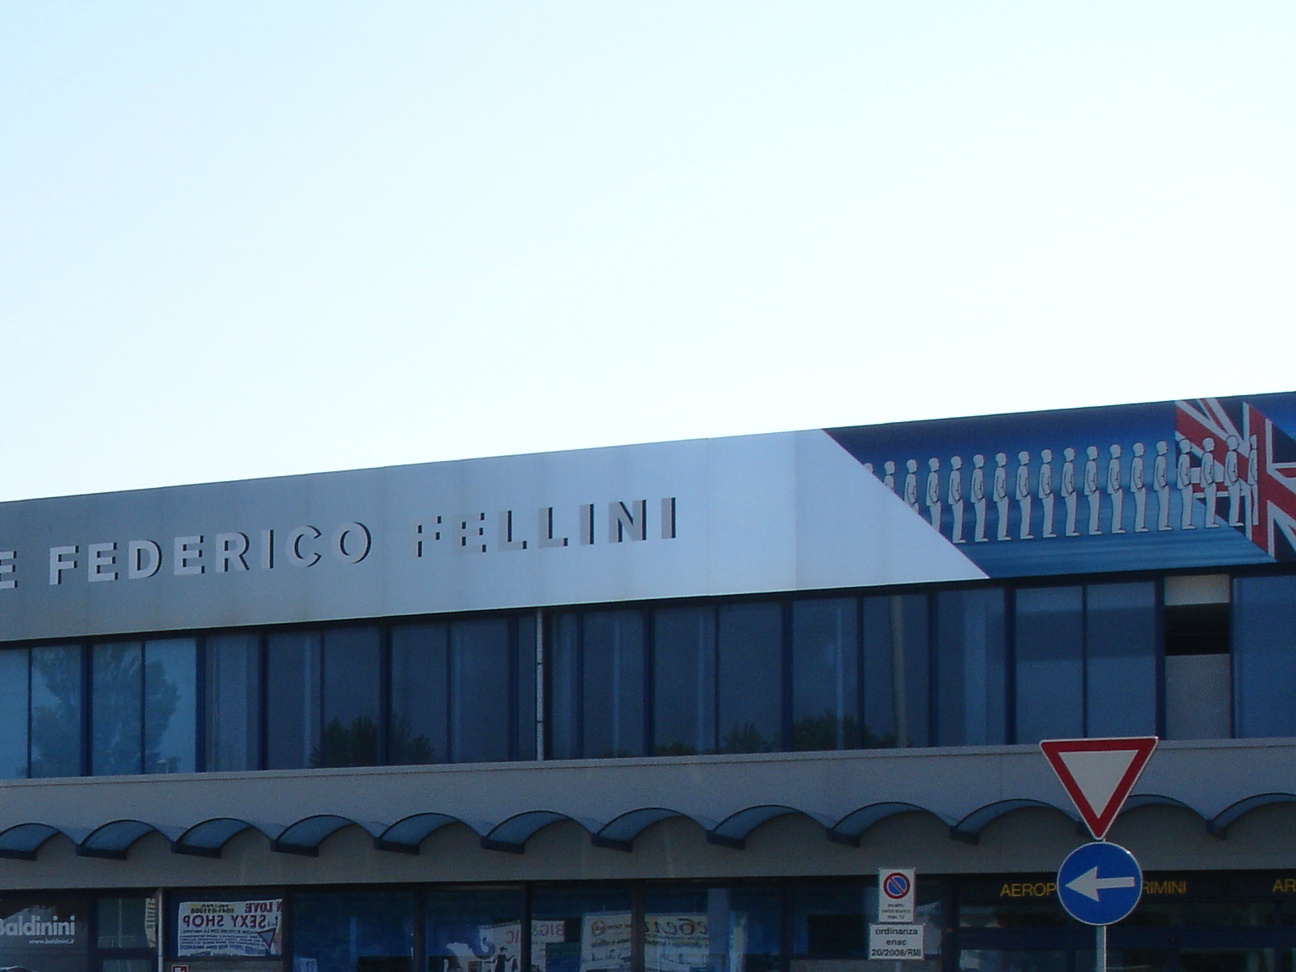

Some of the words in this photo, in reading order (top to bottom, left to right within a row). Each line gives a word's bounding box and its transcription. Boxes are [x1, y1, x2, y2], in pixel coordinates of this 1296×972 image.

[49, 521, 373, 586] FEDERICO
[408, 497, 677, 558] FELLINI
[1000, 883, 1057, 897] AEROP
